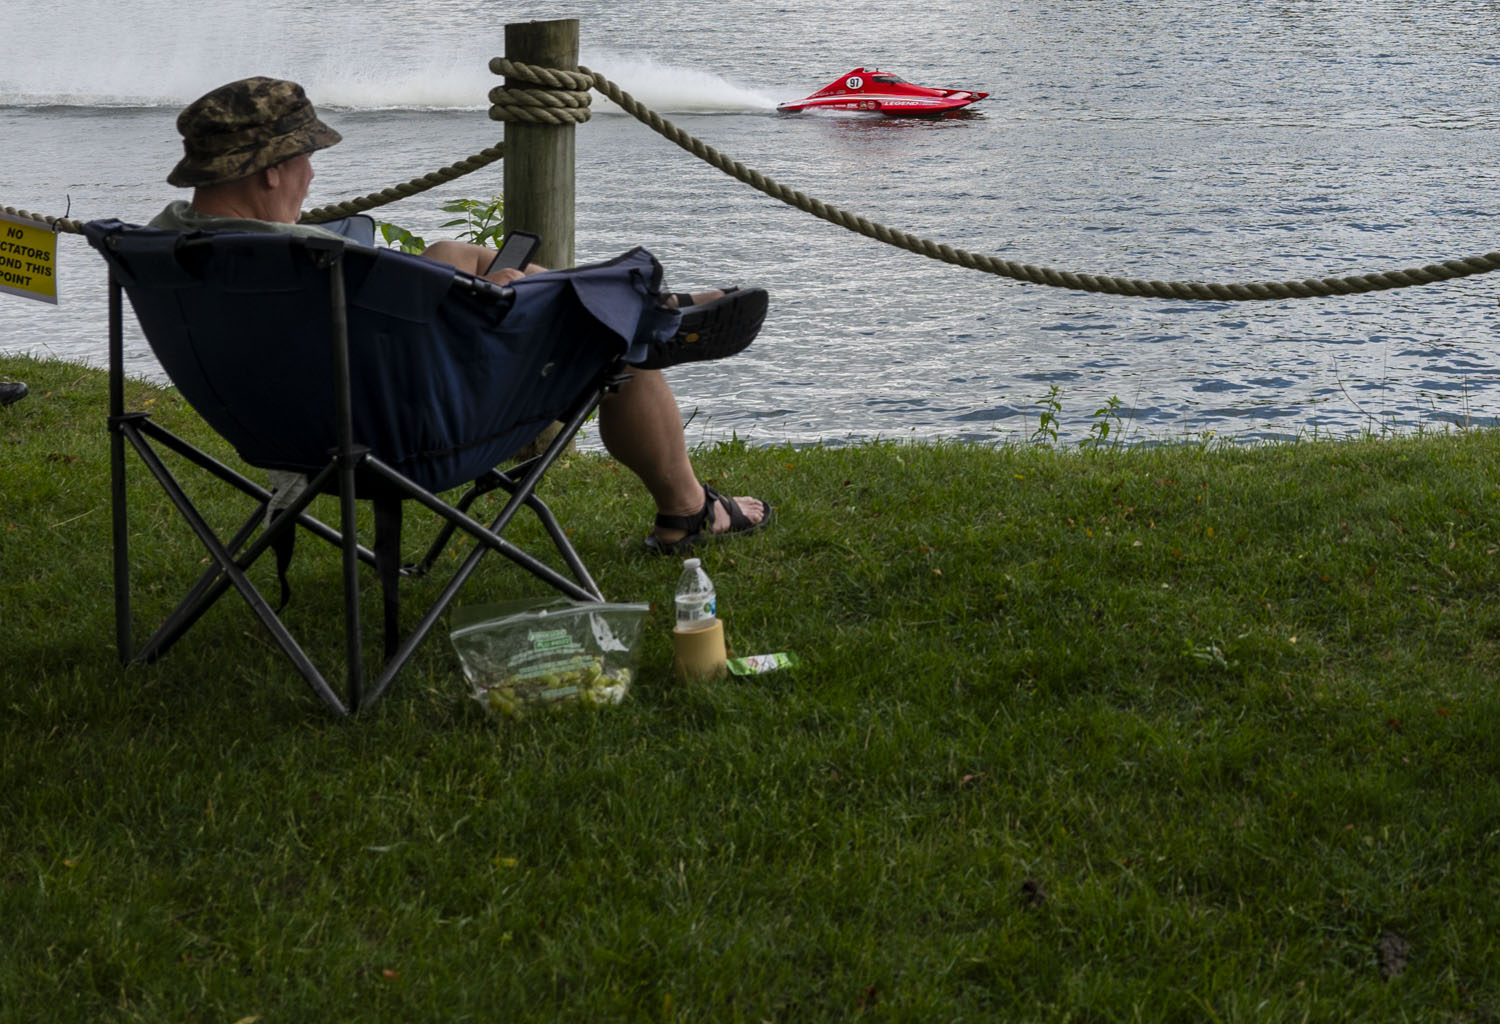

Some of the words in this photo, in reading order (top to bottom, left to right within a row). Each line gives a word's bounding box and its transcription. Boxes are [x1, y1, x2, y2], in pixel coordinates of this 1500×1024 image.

[850, 78, 859, 88] 97
[7, 227, 24, 239] NO
[0, 241, 50, 261] CTATORS
[0, 256, 22, 269] OND
[26, 262, 52, 277] THIS
